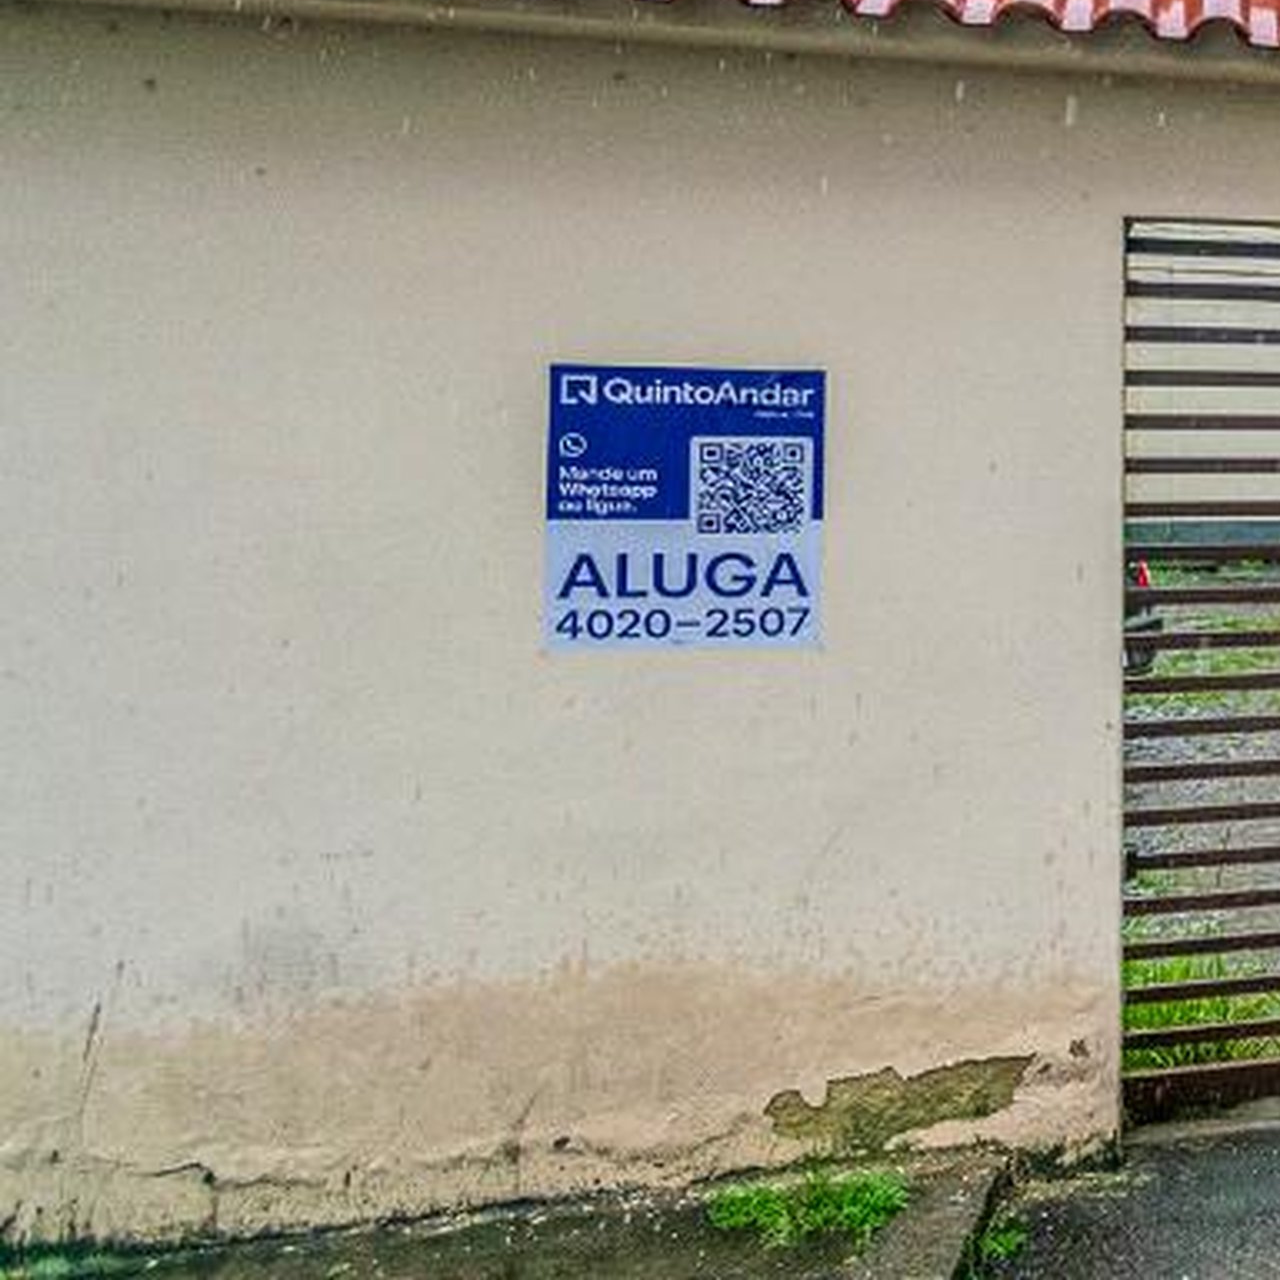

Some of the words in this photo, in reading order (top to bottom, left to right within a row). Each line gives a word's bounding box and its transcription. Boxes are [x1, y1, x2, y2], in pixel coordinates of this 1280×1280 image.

[603, 378, 814, 407] QuintoAndar
[559, 466, 624, 481] Mande
[626, 469, 658, 481] um
[556, 553, 809, 599] ALUGA
[556, 607, 811, 640] 4020-2507
